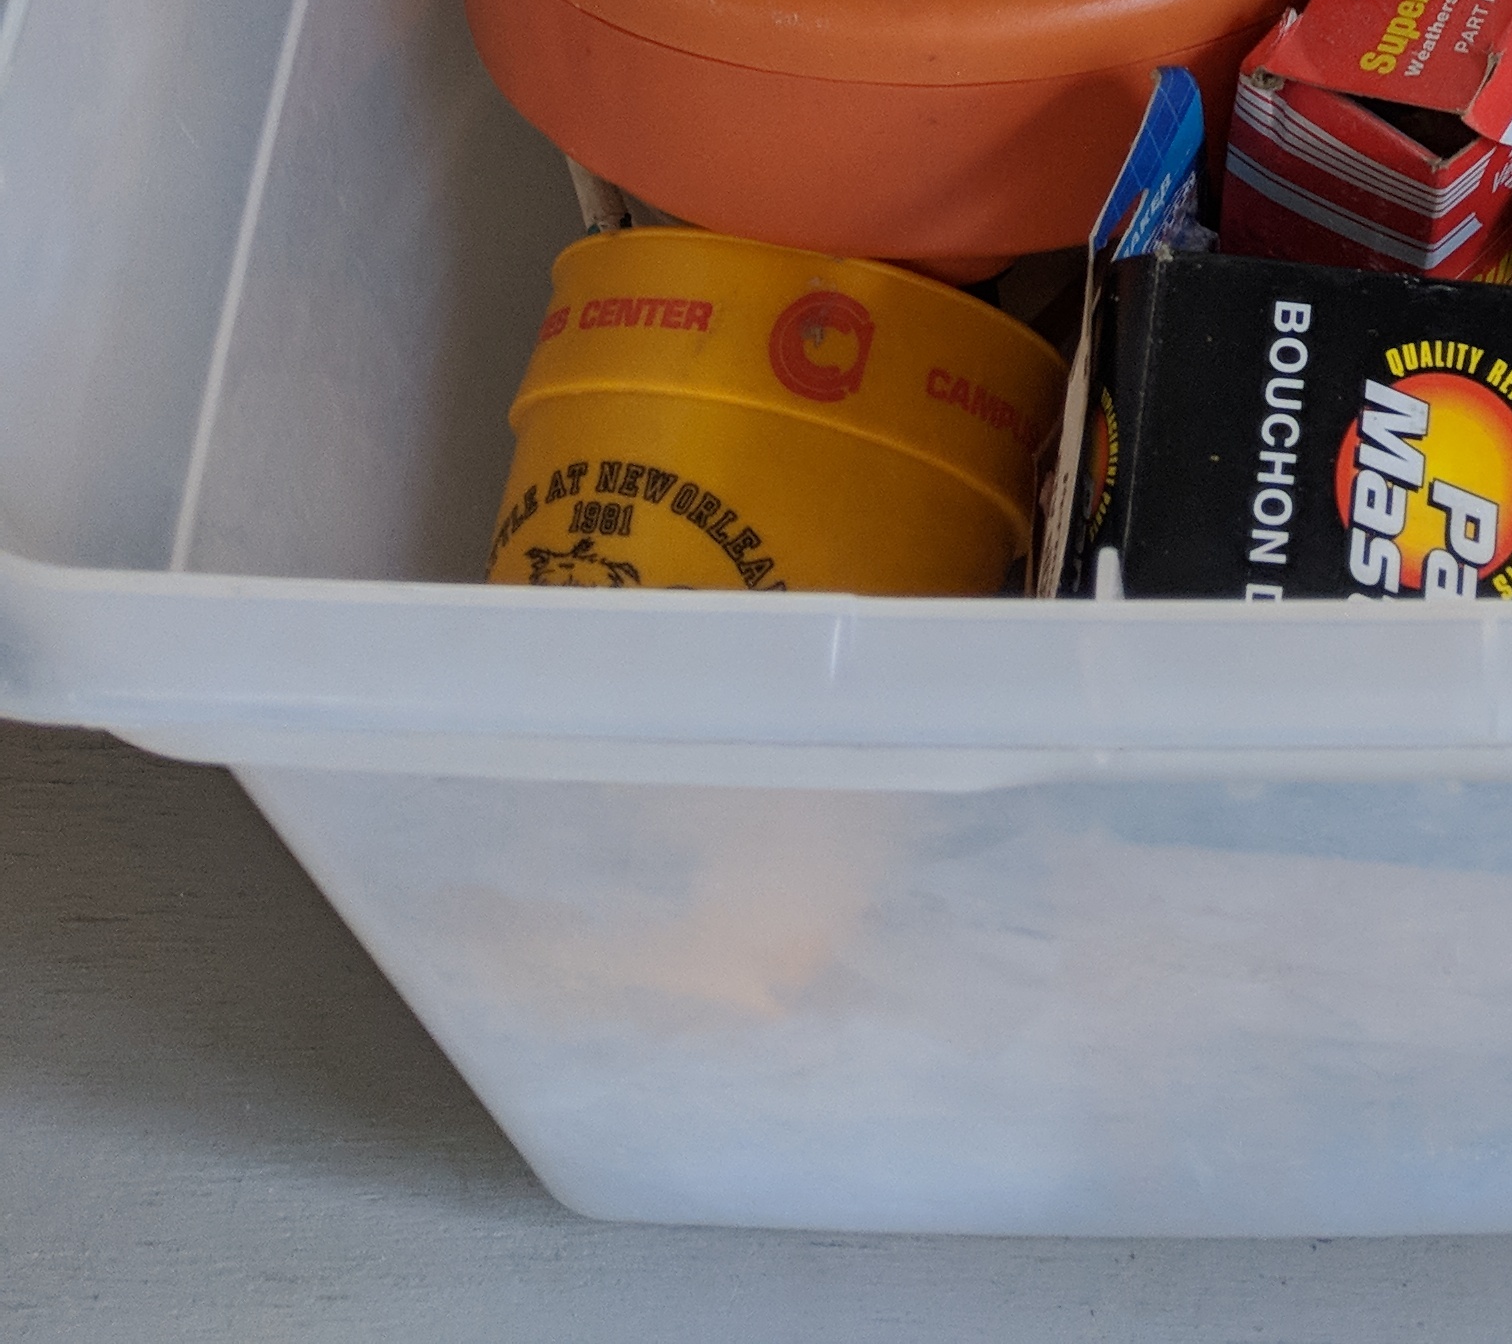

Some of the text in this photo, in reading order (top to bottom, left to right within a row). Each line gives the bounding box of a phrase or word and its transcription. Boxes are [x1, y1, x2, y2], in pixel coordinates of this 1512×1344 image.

[1453, 4, 1489, 54] PART
[578, 296, 714, 333] CENTER
[1384, 339, 1485, 379] QUALITY
[1248, 300, 1312, 564] BOUCHON
[544, 460, 589, 505] AT
[595, 460, 679, 505] NEW
[1349, 378, 1431, 601] Mas
[568, 500, 635, 537] 1981
